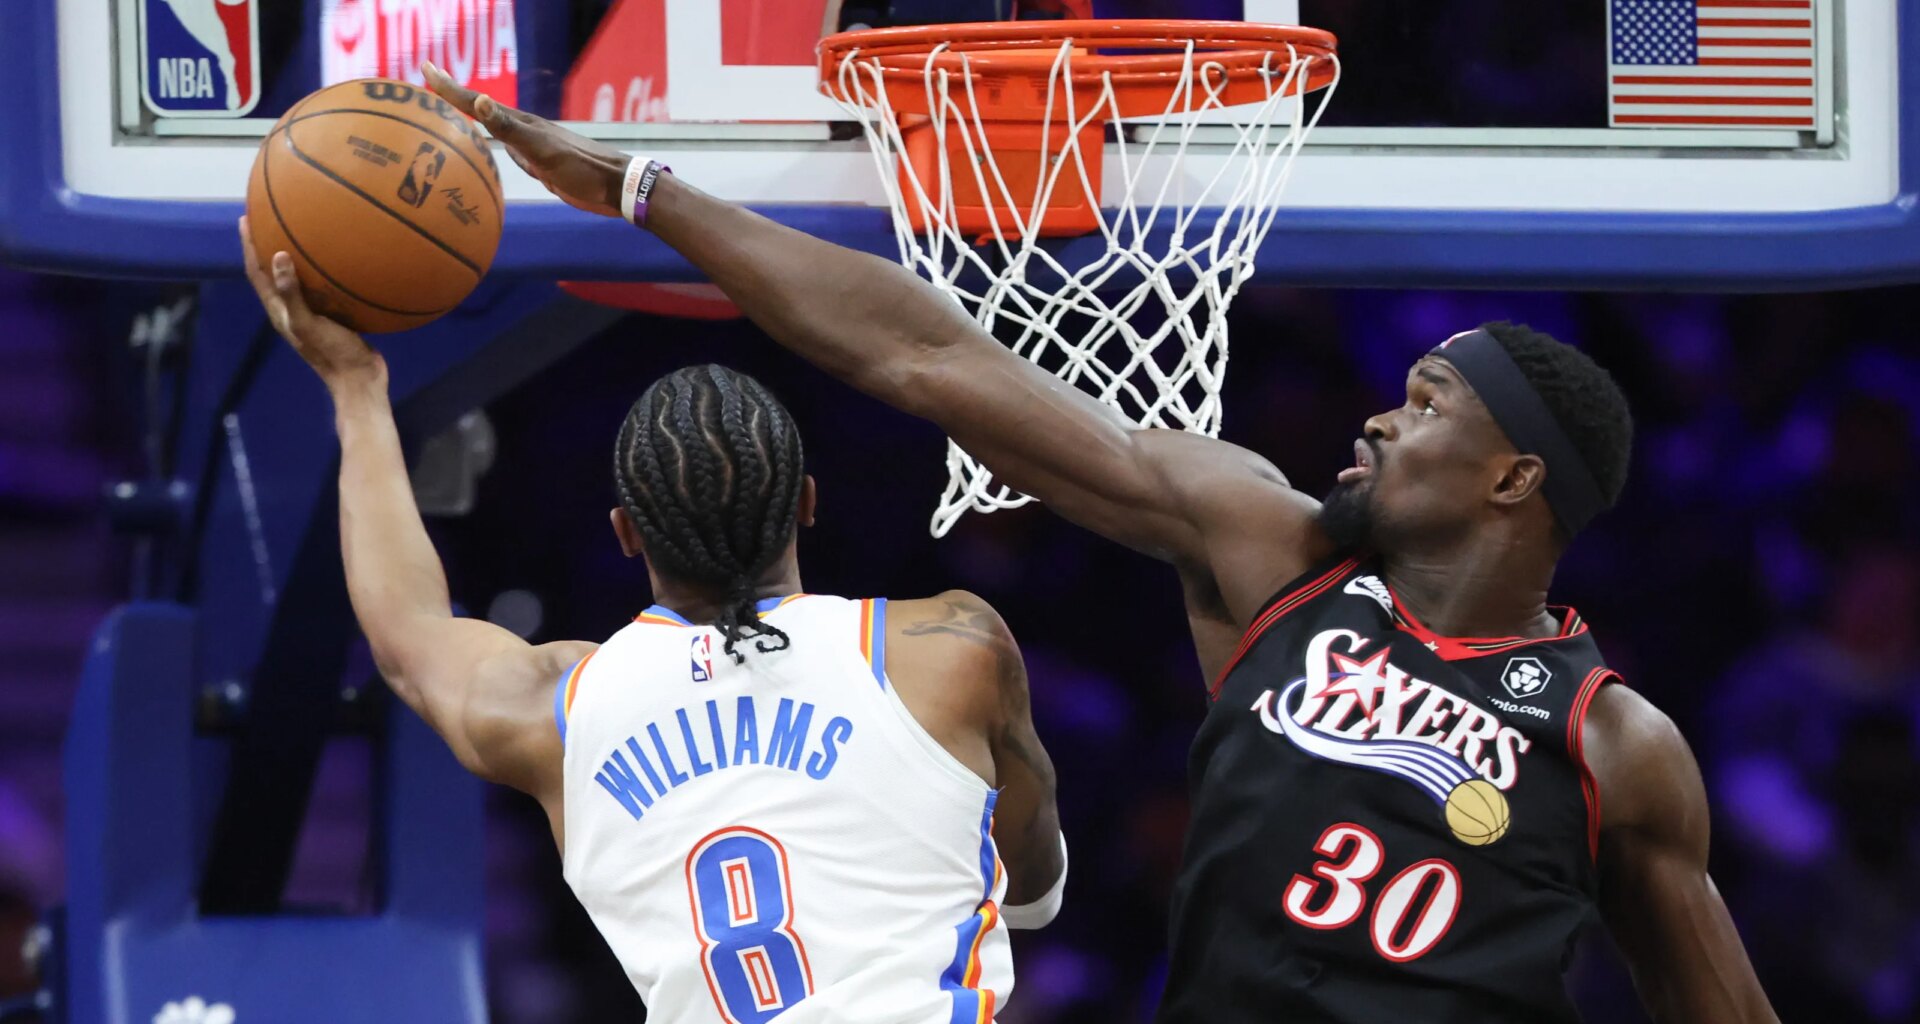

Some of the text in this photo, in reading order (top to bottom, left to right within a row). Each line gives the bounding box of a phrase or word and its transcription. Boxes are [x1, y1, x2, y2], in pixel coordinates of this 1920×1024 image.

[158, 57, 215, 99] NBA
[379, 0, 518, 87] TOYOTA
[637, 169, 655, 204] GLORY
[594, 696, 853, 821] WILLIAMS
[1250, 628, 1533, 791] SIXERS
[685, 825, 815, 1024] 8
[1282, 821, 1463, 963] 30
